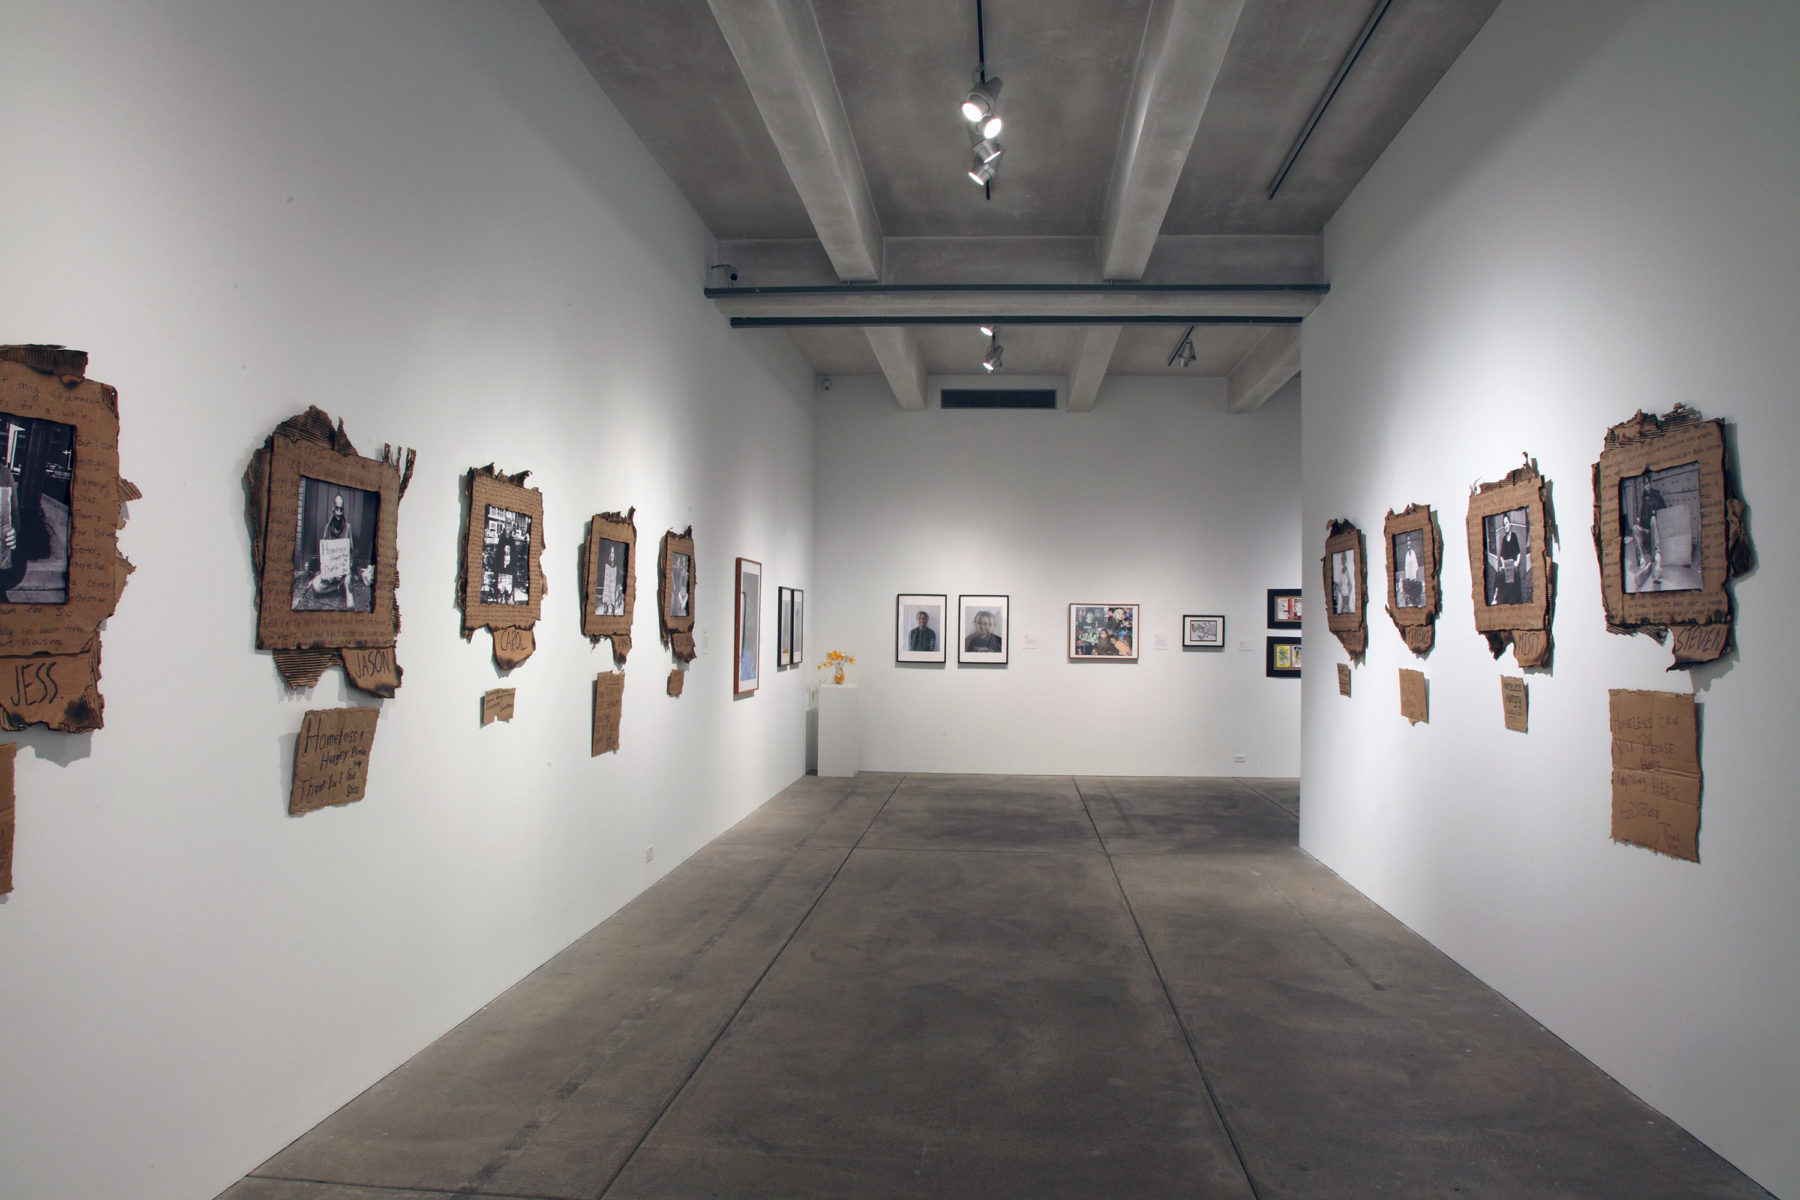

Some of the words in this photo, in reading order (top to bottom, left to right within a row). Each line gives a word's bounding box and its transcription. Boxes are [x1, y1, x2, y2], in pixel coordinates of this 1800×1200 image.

[500, 630, 528, 651] CAROL
[1676, 626, 1722, 652] STEVEN
[355, 651, 391, 678] JASON
[10, 662, 58, 707] JESS
[303, 716, 358, 754] Homeless
[319, 749, 349, 772] Hungry
